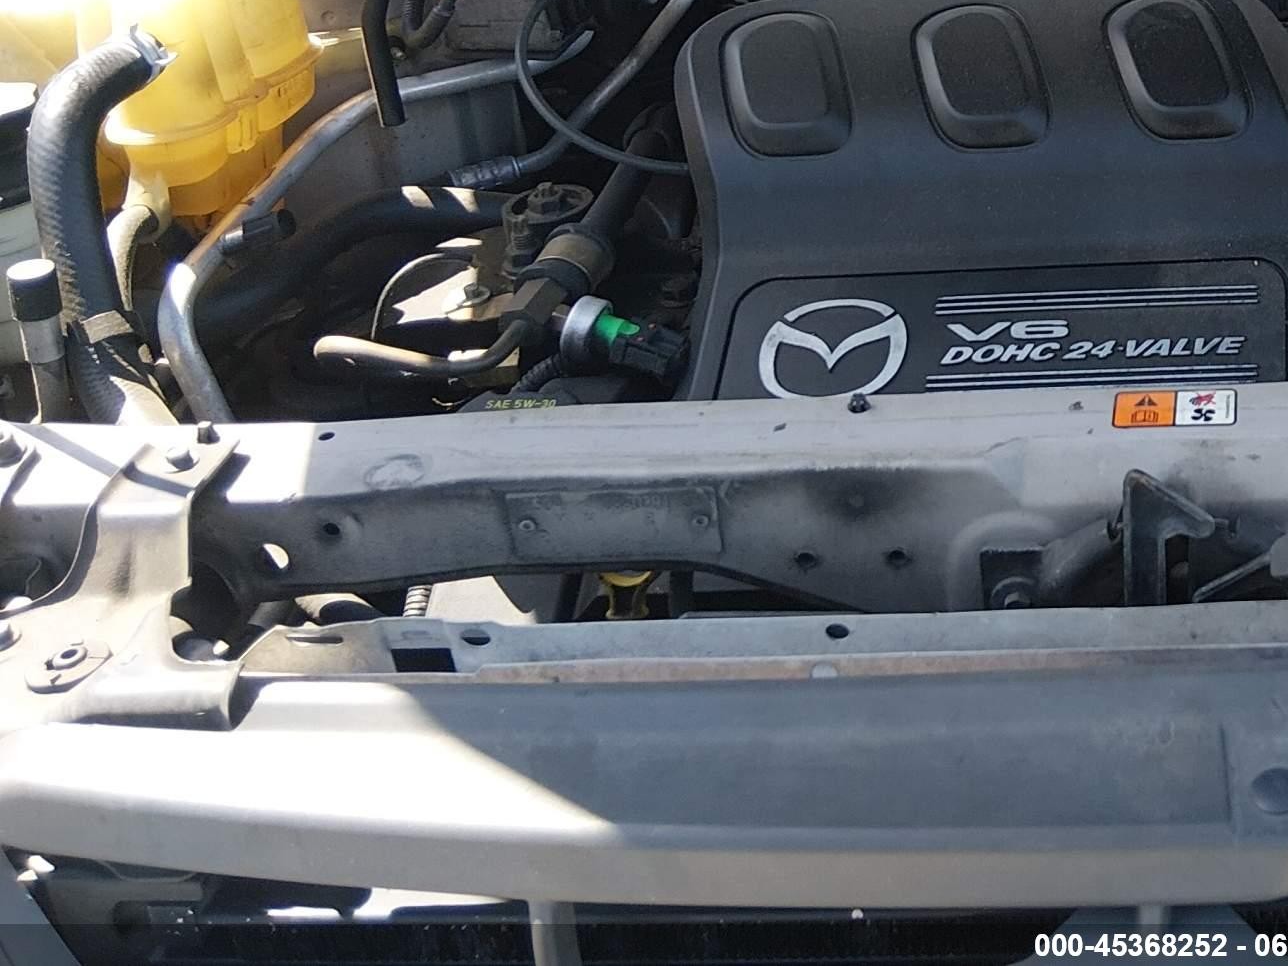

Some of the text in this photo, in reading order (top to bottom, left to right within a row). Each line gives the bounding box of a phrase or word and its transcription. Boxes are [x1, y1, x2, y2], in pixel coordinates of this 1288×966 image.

[947, 320, 1069, 342] V6
[940, 342, 1061, 364] DOHC
[486, 399, 512, 409] SAE
